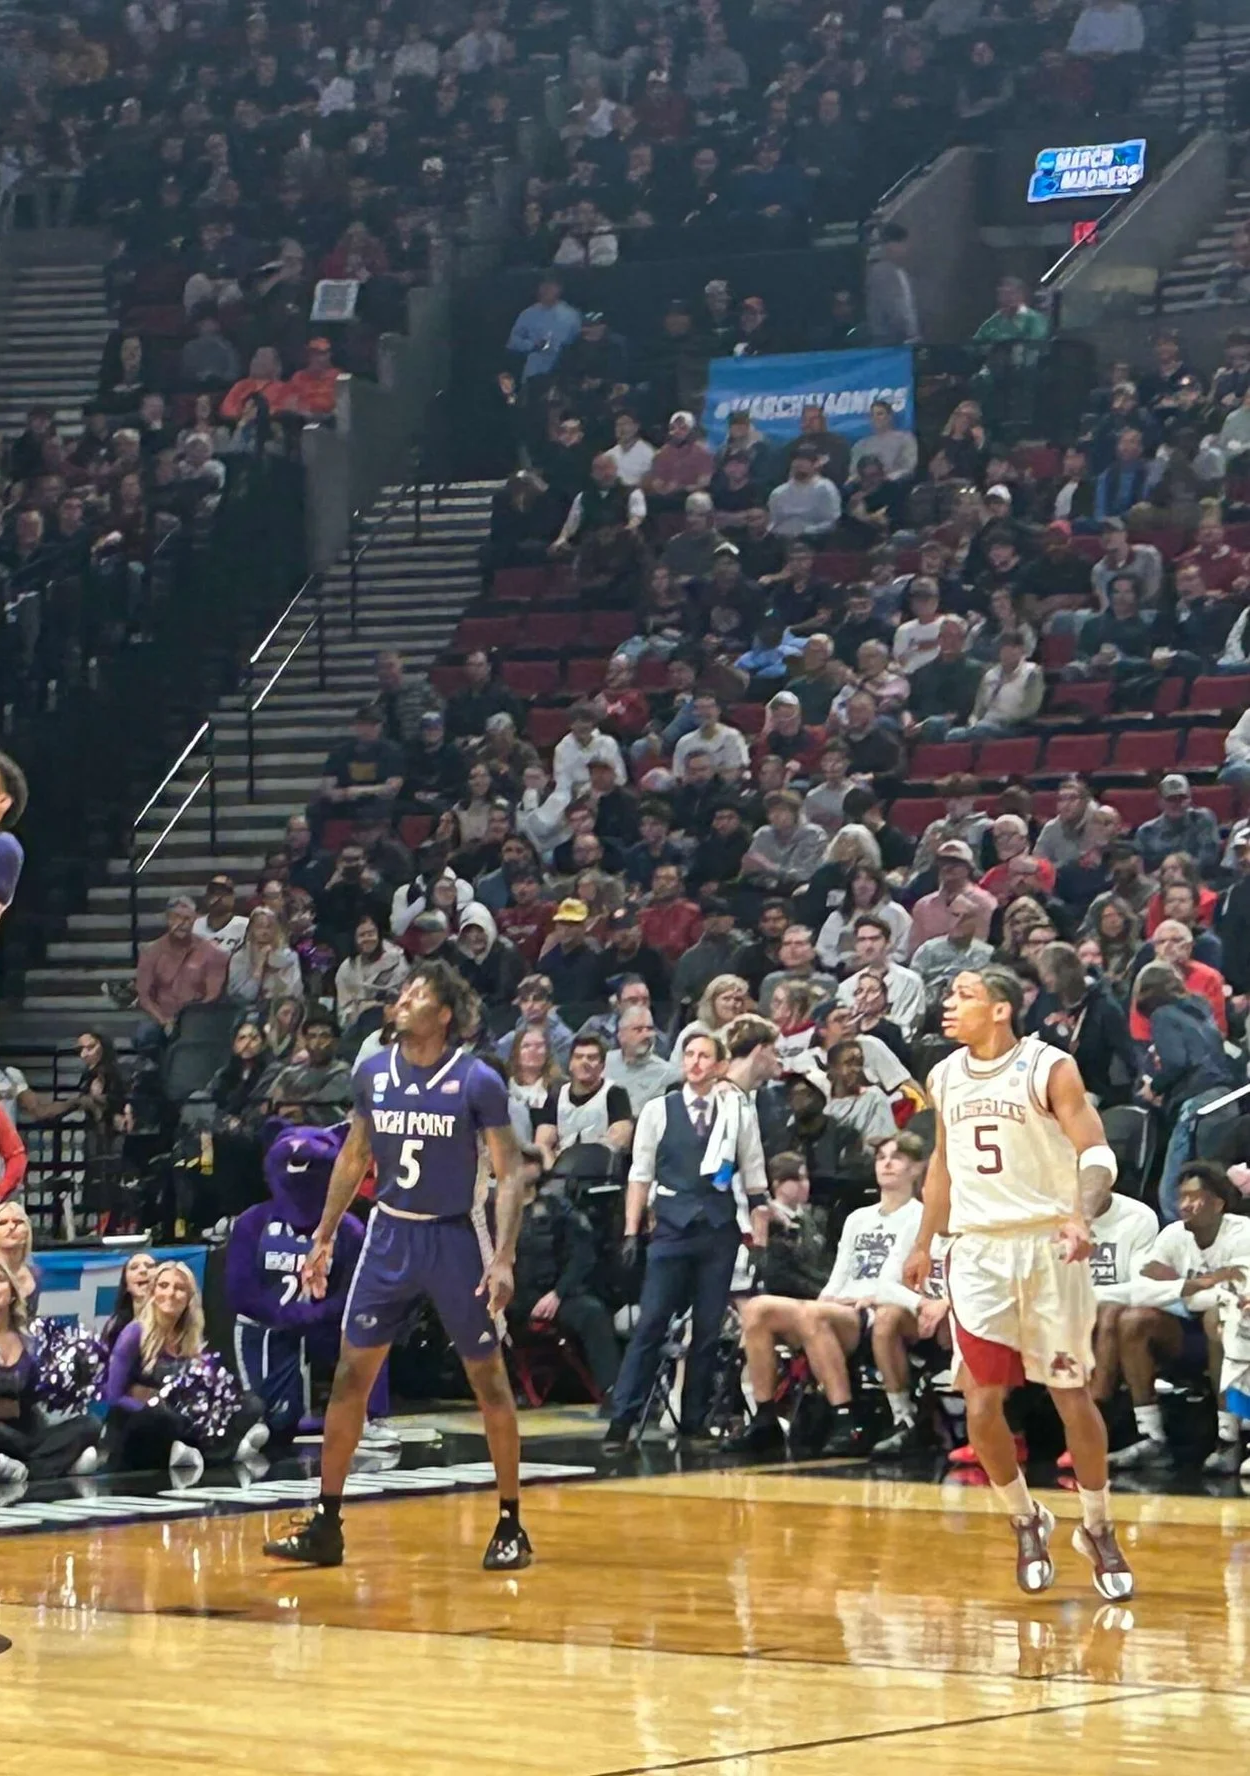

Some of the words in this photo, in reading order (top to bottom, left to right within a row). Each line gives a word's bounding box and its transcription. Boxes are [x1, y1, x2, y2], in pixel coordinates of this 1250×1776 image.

[1054, 148, 1115, 172] MARCH
[1060, 163, 1141, 189] MADNESS
[407, 1111, 456, 1138] POINT
[974, 1124, 1003, 1175] 5
[396, 1139, 424, 1190] 5
